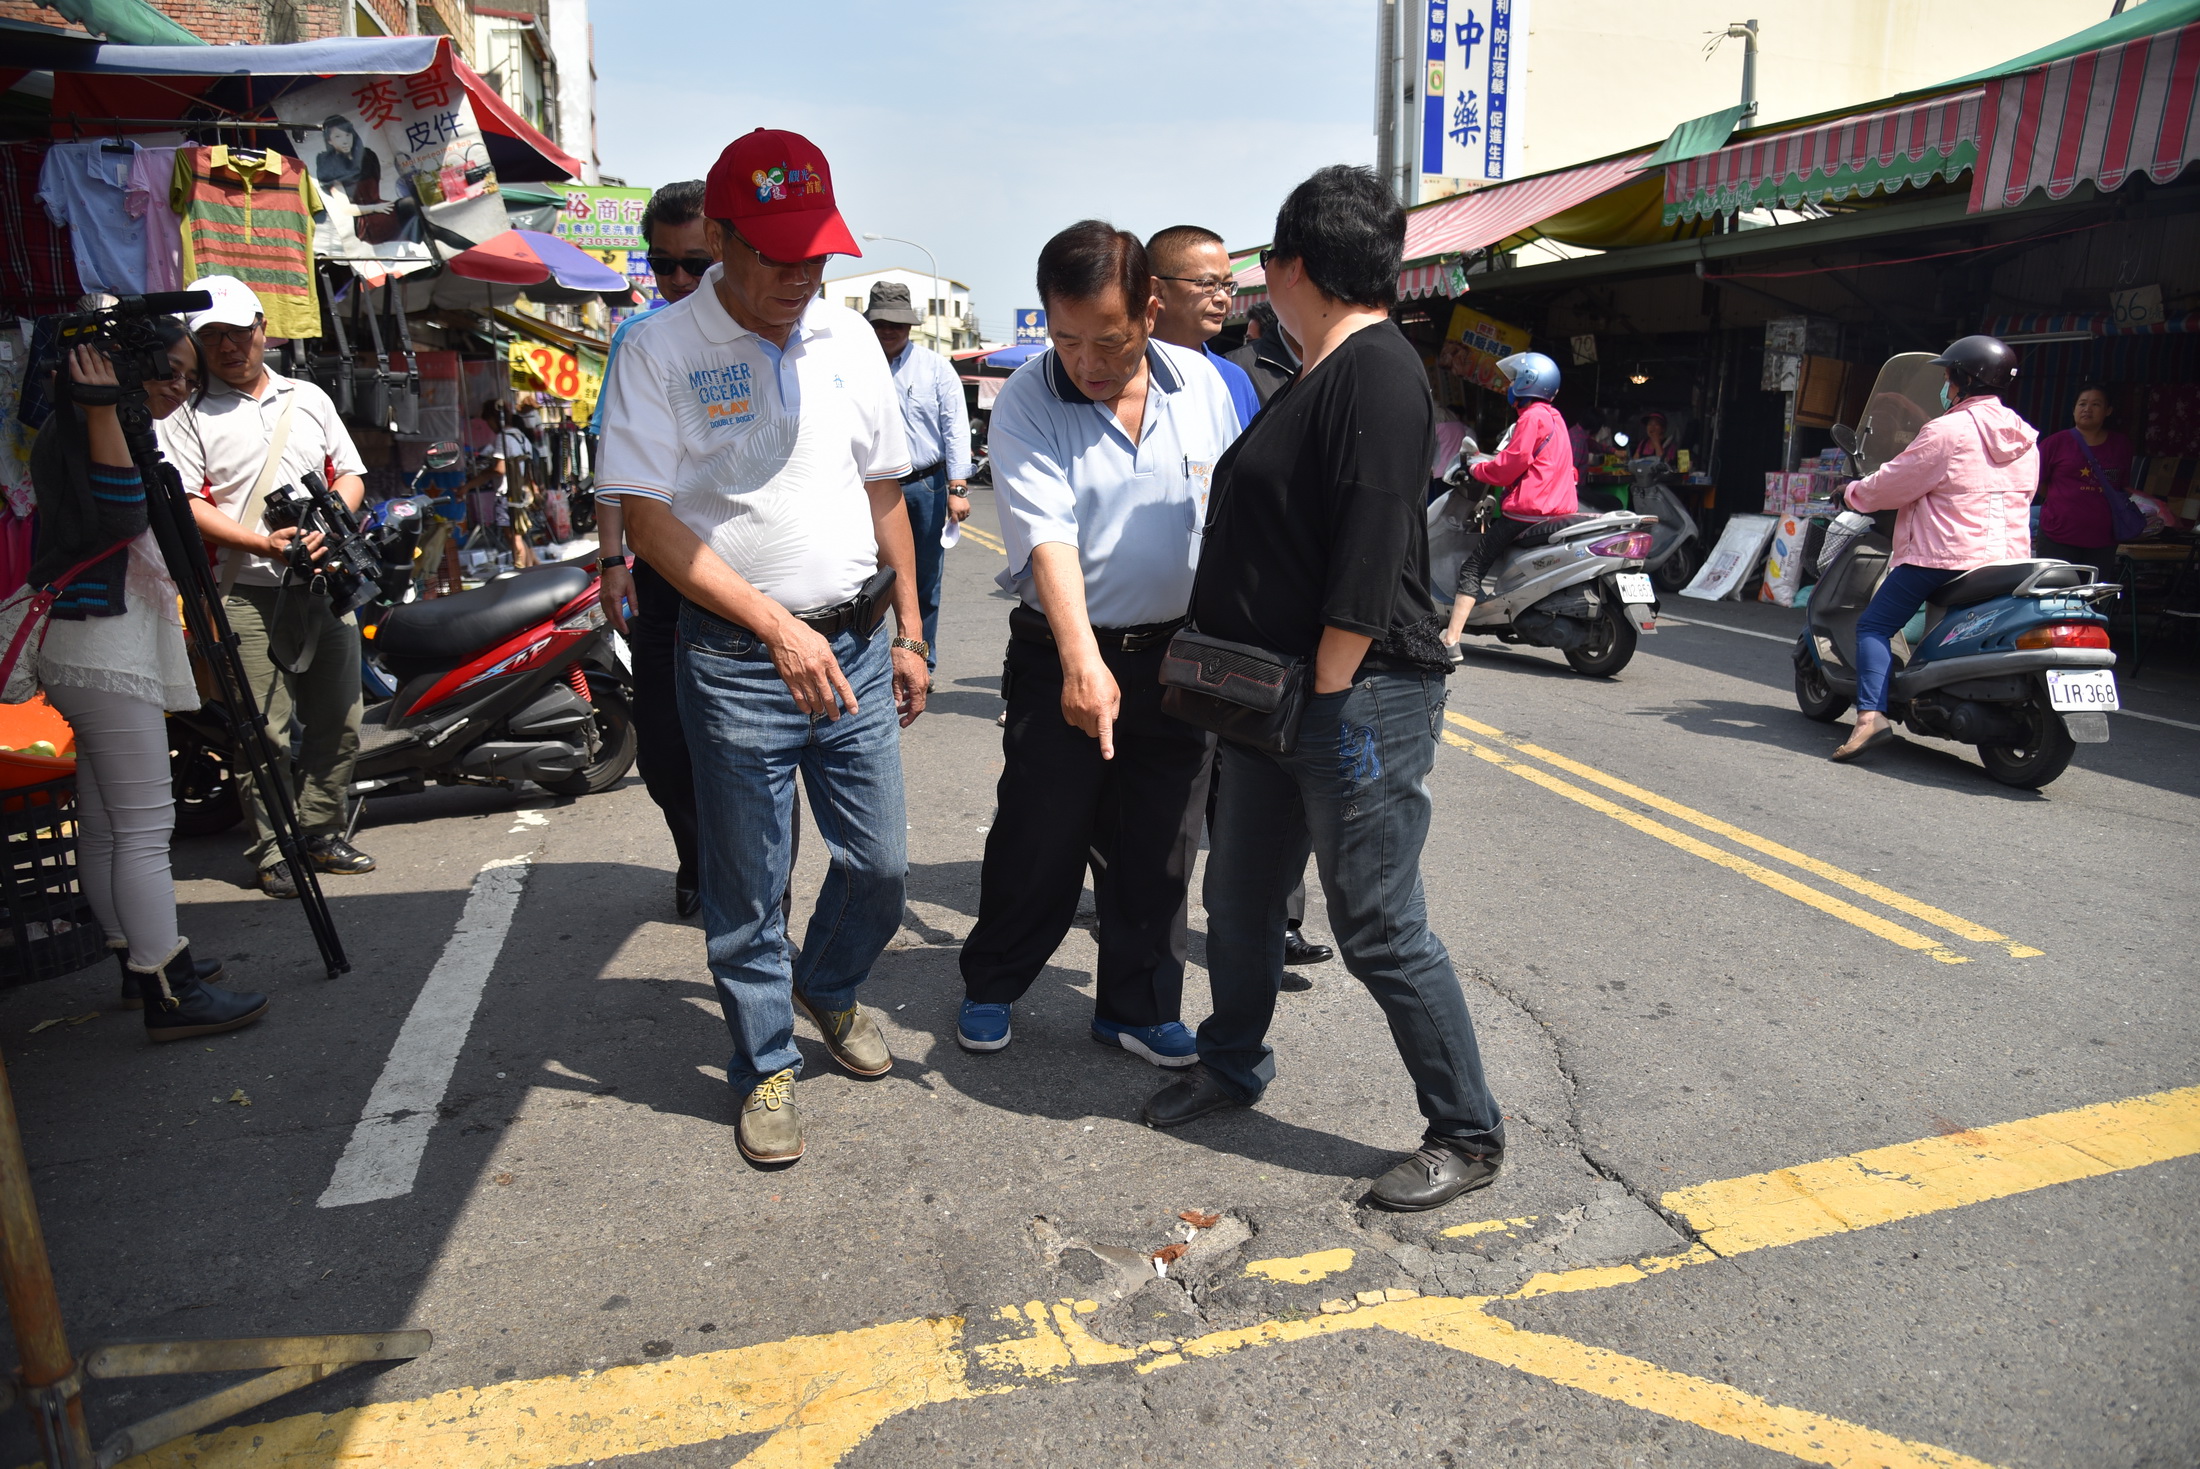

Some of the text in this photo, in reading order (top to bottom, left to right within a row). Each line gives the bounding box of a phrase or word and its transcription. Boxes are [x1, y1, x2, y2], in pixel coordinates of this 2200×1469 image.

[1448, 8, 1485, 148] 中藥
[352, 63, 451, 131] 麥哥
[405, 111, 464, 153] 皮件
[805, 180, 822, 194] 首都
[577, 237, 639, 247] 2305525
[2114, 291, 2147, 322] 66
[528, 348, 580, 398] 38
[688, 362, 752, 391] MOTHER
[698, 380, 752, 404] OCEAN
[707, 400, 749, 419] PLAY
[710, 417, 734, 429] DOUBLE
